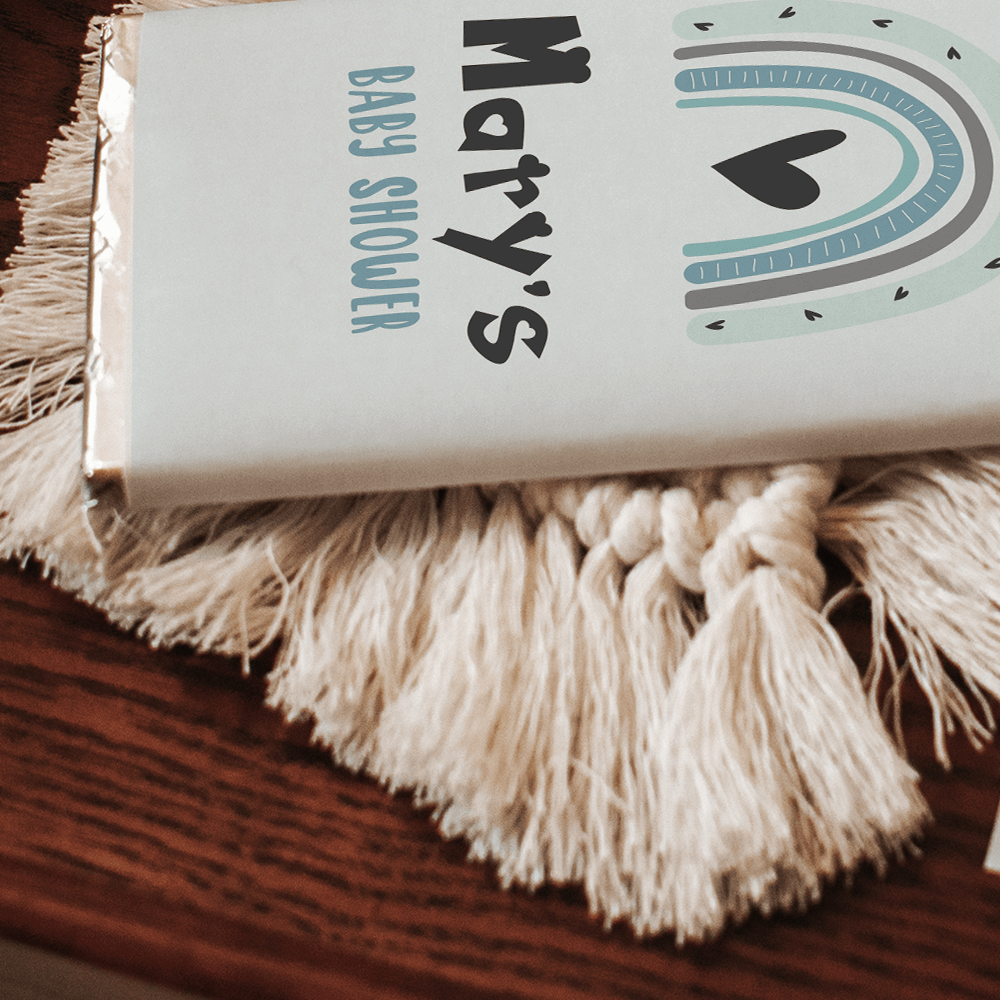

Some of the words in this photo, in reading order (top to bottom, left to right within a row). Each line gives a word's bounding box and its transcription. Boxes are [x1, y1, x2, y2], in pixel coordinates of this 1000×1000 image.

[347, 66, 417, 158] BABY
[432, 15, 592, 364] Mary's
[350, 177, 420, 334] SHOWER
